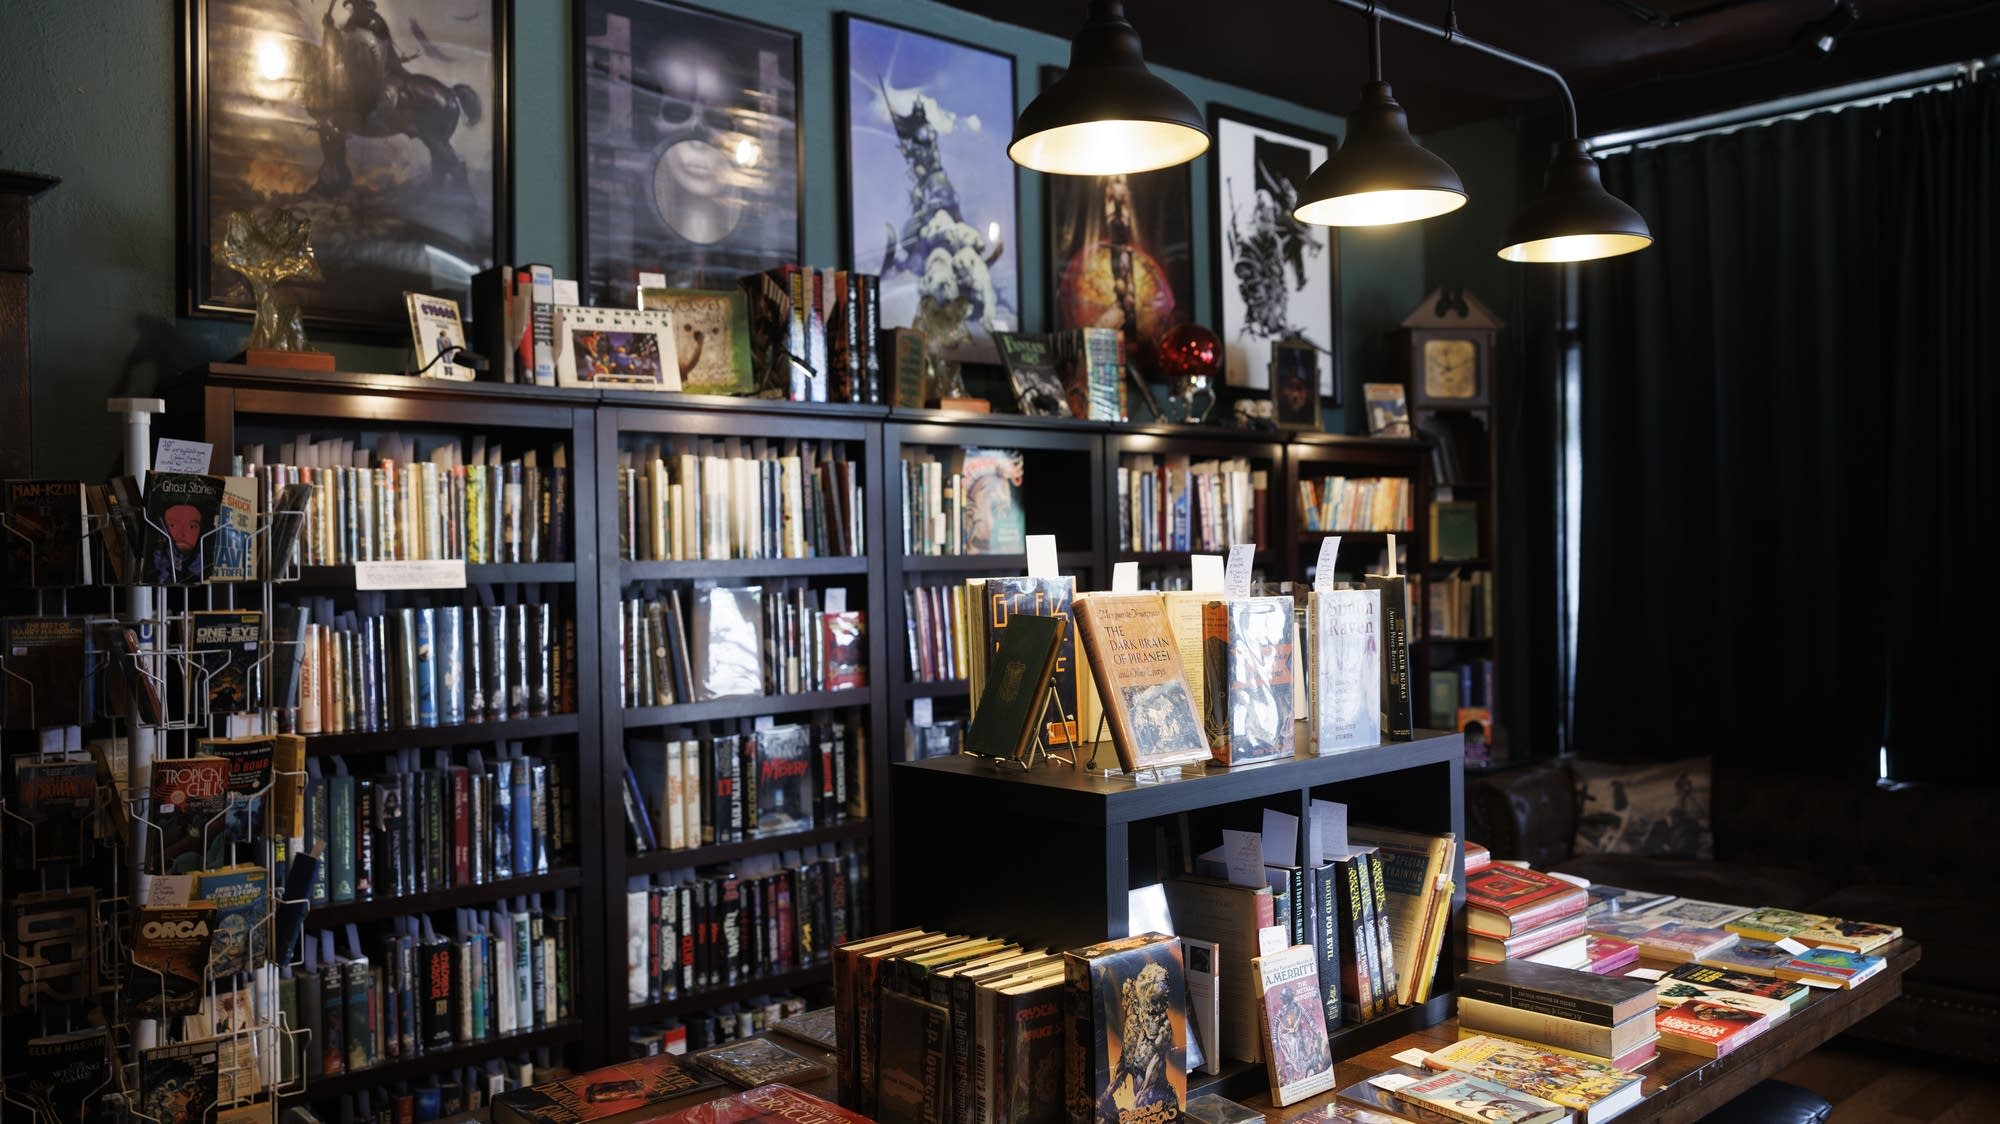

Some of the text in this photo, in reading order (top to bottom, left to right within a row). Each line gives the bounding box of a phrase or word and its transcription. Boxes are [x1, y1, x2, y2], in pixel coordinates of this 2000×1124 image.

[162, 480, 187, 494] Ghost
[196, 626, 259, 639] ONE-EYE
[1104, 625, 1125, 637] THE
[1329, 618, 1373, 636] Raven
[1109, 637, 1169, 651] DARK BRAIN
[1113, 650, 1171, 665] OF PIRANESI
[1399, 672, 1407, 700] DUMAS
[159, 767, 224, 785] TROPICAL
[186, 782, 224, 797] CHILLS
[142, 920, 210, 939] ORCA
[1356, 925, 1366, 955] Collected
